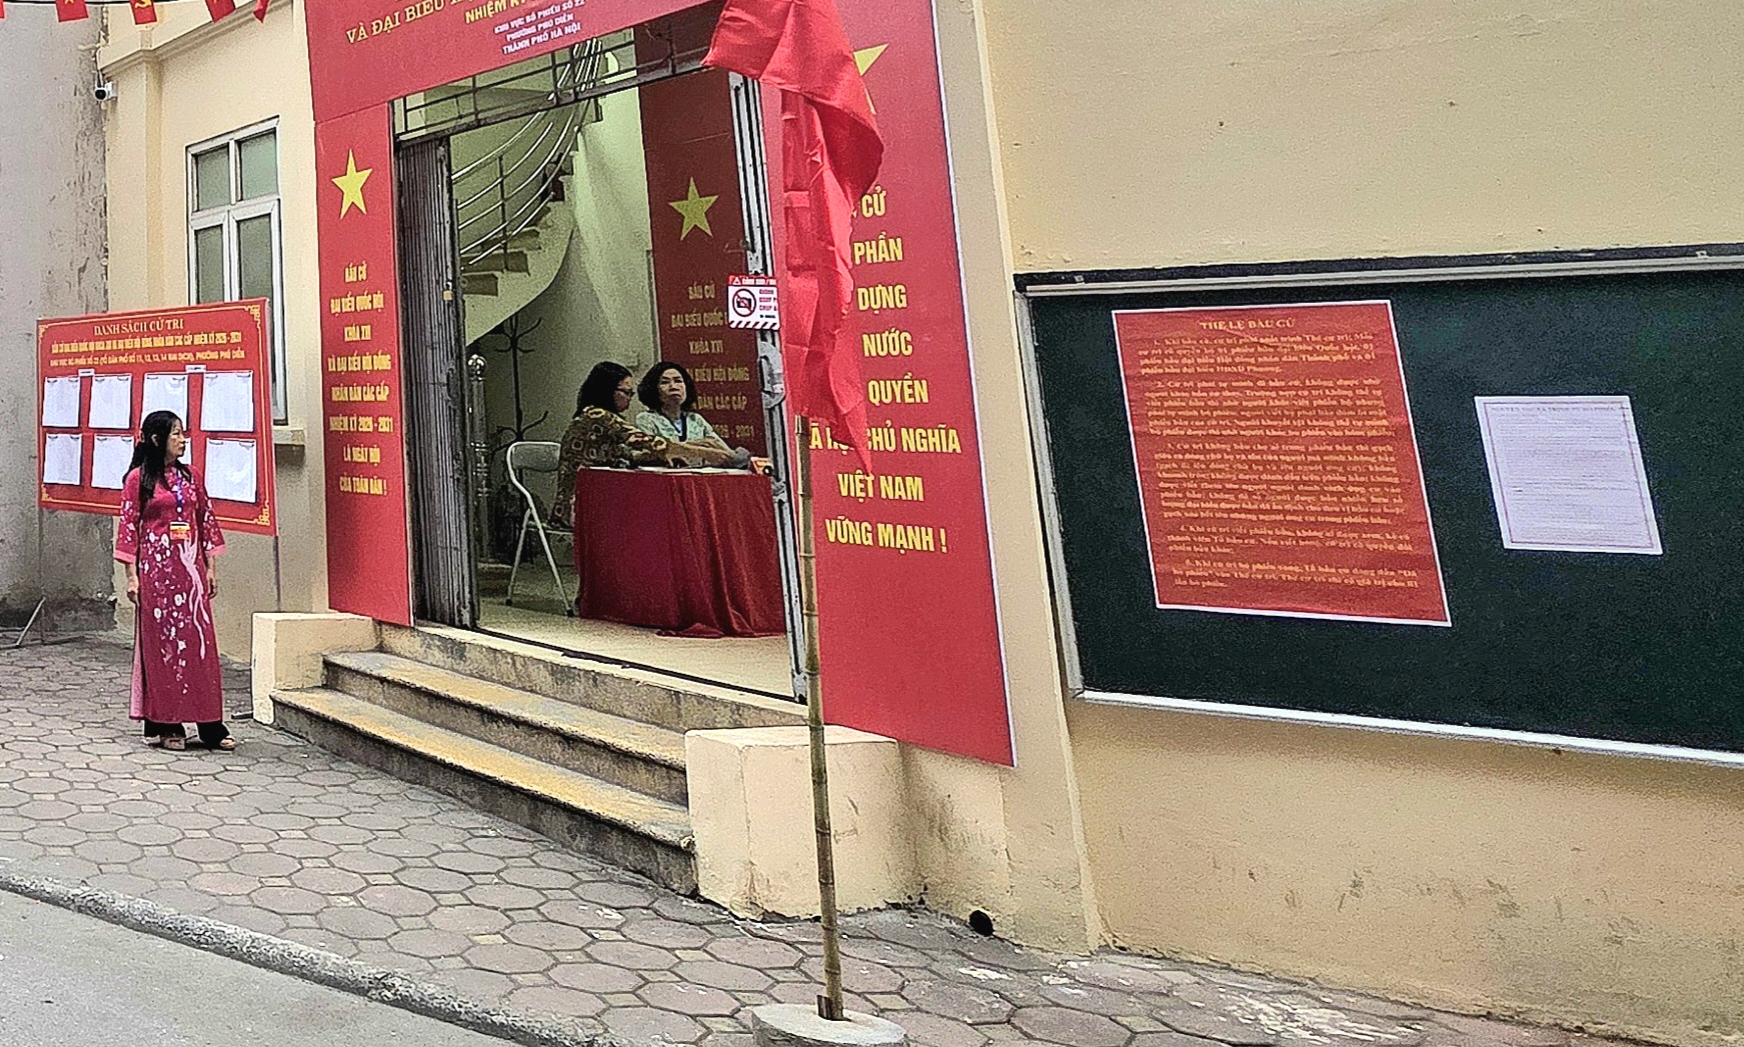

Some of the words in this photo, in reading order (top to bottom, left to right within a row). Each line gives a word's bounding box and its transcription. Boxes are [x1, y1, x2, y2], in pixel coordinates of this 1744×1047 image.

[347, 22, 368, 43] VÀ
[372, 12, 401, 35] ĐẠI
[503, 40, 530, 54] THÀNH
[531, 32, 548, 45] PHỐ
[551, 27, 563, 39] HÀ
[565, 22, 580, 34] NỘI
[861, 186, 886, 218] CỬ
[854, 232, 903, 264] PHẦN
[858, 284, 907, 314] DỰNG
[94, 325, 120, 335] DANH
[121, 320, 147, 333] SÁCH
[165, 319, 183, 329] TRI
[863, 328, 913, 357] NƯỚC
[868, 372, 929, 406] QUYỀN
[868, 420, 896, 452] HỦ
[902, 424, 961, 454] NGHĨA
[838, 470, 875, 502] VIỆT
[880, 476, 924, 501] NAM
[825, 516, 873, 546] VỮNG
[877, 523, 935, 554] MẠNH
